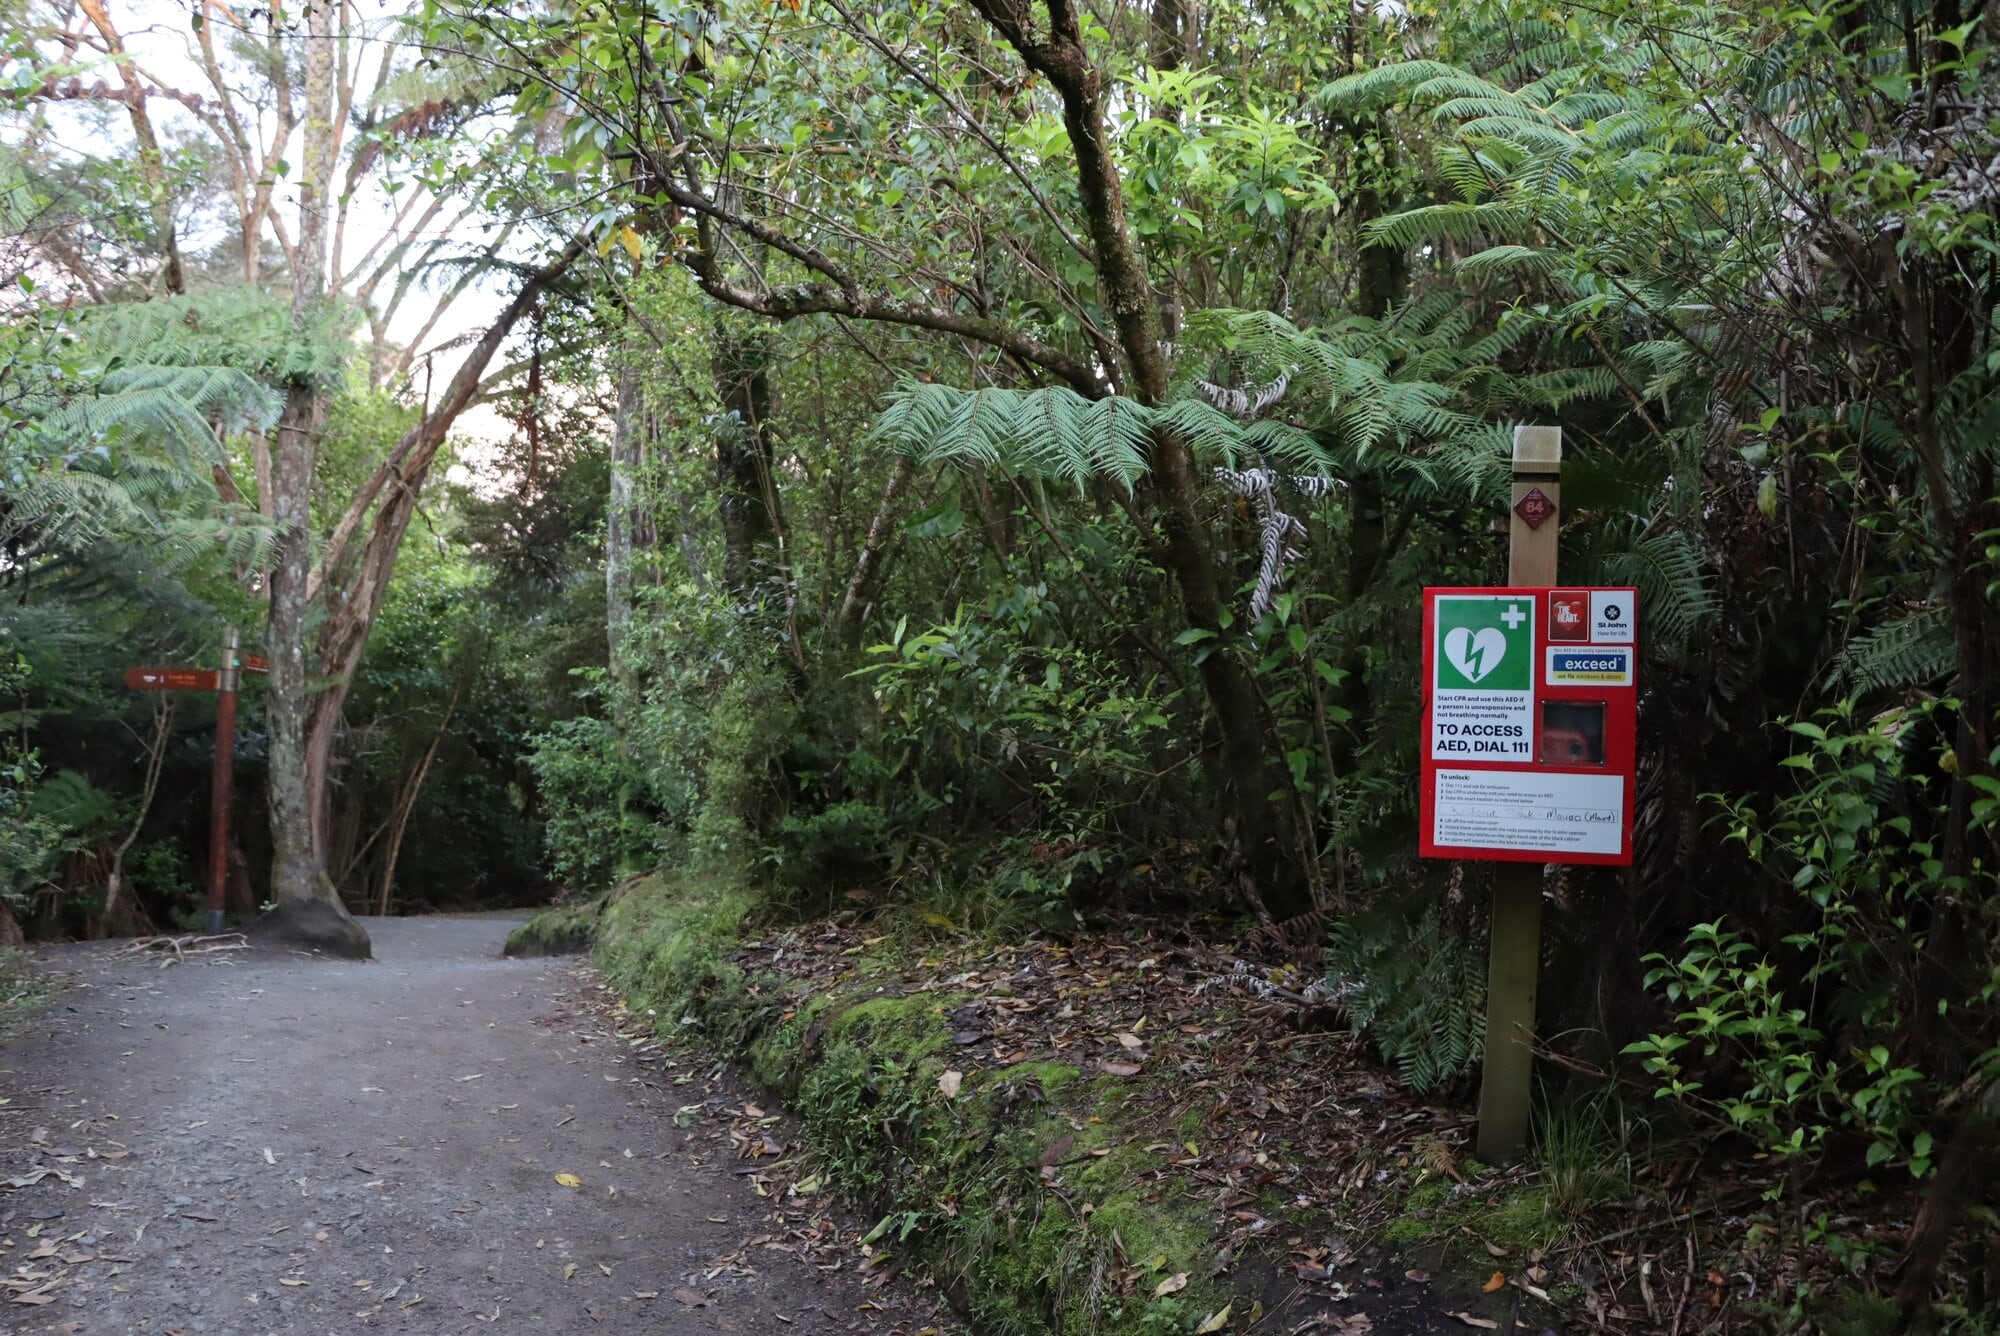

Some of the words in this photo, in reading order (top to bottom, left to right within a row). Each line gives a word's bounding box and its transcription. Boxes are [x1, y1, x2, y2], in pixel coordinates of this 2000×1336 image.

[1558, 605, 1570, 614] THE
[1565, 657, 1617, 670] exceed
[1437, 724, 1458, 735] TO
[1461, 724, 1523, 737] ACCESS
[1437, 740, 1471, 753] AED,
[1474, 740, 1509, 753] DIAL
[1512, 741, 1529, 753] 111
